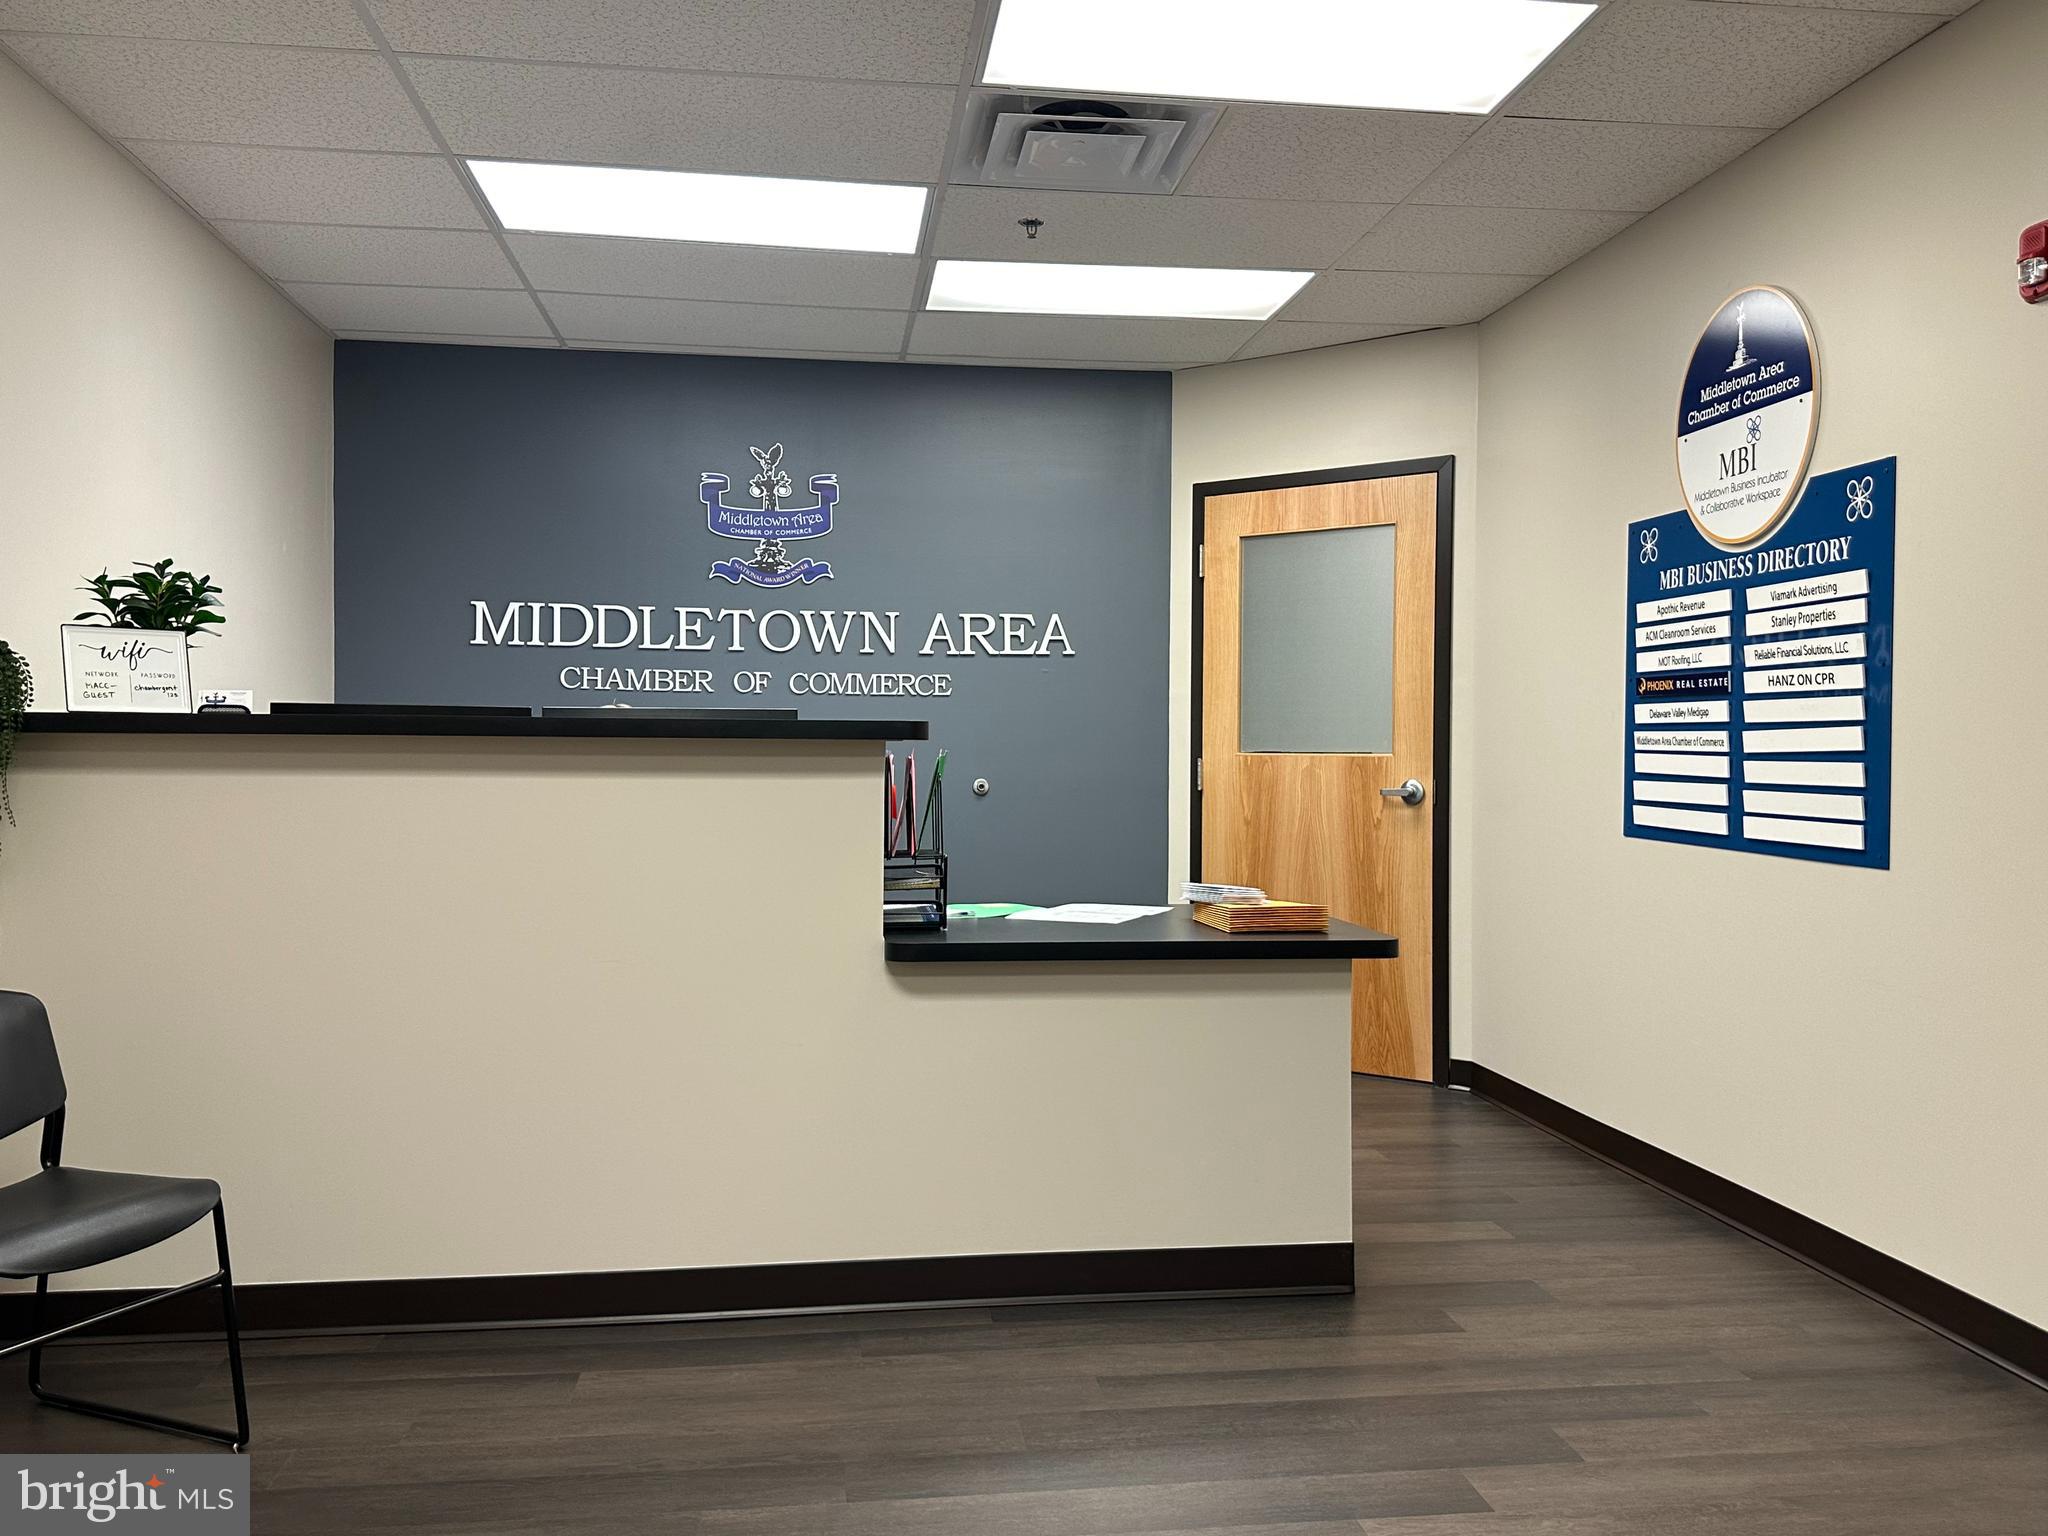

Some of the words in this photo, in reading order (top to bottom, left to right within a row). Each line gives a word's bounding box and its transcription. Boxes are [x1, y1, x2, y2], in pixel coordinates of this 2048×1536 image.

[1700, 372, 1757, 403] Middletown
[1758, 360, 1785, 381] Area
[1687, 401, 1730, 426] Chamber
[1731, 396, 1742, 410] of
[1742, 375, 1800, 406] Commerce
[1718, 443, 1758, 481] MBI
[1694, 485, 1730, 503] Middletown
[1731, 475, 1756, 494] Business
[1756, 468, 1789, 486] Incubator
[1700, 505, 1706, 516] &
[1705, 496, 1745, 515] Collaborative
[1745, 486, 1782, 504] Workspace
[719, 511, 789, 527] Middletown
[791, 513, 823, 527] Area
[730, 527, 762, 536] CHAMBER
[775, 527, 812, 536] COMMERCE
[733, 562, 763, 582] NATIONAL
[763, 575, 785, 583] AWARD
[783, 562, 809, 582] WINNER
[1659, 566, 1684, 591] MBI
[1687, 553, 1753, 586] BUSINESS
[1756, 536, 1853, 574] DIRECTORY
[1770, 587, 1797, 602] Viamark
[1798, 582, 1838, 596] Advertising
[1656, 604, 1679, 617] Apothic
[1680, 600, 1706, 612] Revenue
[1771, 613, 1797, 628] Stanley
[1798, 608, 1837, 625] Properties
[469, 600, 901, 655] MIDDLETOWN
[919, 612, 1075, 656] AREA
[1645, 630, 1659, 641] ACM
[1659, 627, 1691, 640] Cleanroom
[1691, 623, 1716, 636] Services
[1658, 656, 1671, 667] MOT
[1691, 652, 1703, 664] LLC
[1754, 648, 1777, 661] Reliable
[1777, 645, 1803, 659] Financial
[1803, 642, 1835, 656] Solutions,
[1834, 641, 1849, 654] LLC
[560, 666, 714, 694] CHAMBER
[733, 670, 772, 694] OF
[789, 671, 953, 697] COMMERCE
[1647, 679, 1674, 691] PHOENIX
[1676, 679, 1695, 689] REAL
[1698, 677, 1728, 688] ESTATE
[1767, 674, 1795, 687] HANZ
[1797, 673, 1812, 686] ON
[1815, 672, 1835, 685] CPR
[1649, 708, 1672, 719] Delaware
[1673, 708, 1686, 720] Valley
[1687, 706, 1710, 720] Medigap
[1673, 736, 1693, 747] Chamber
[1693, 736, 1700, 746] of
[1699, 736, 1725, 747] Commerce
